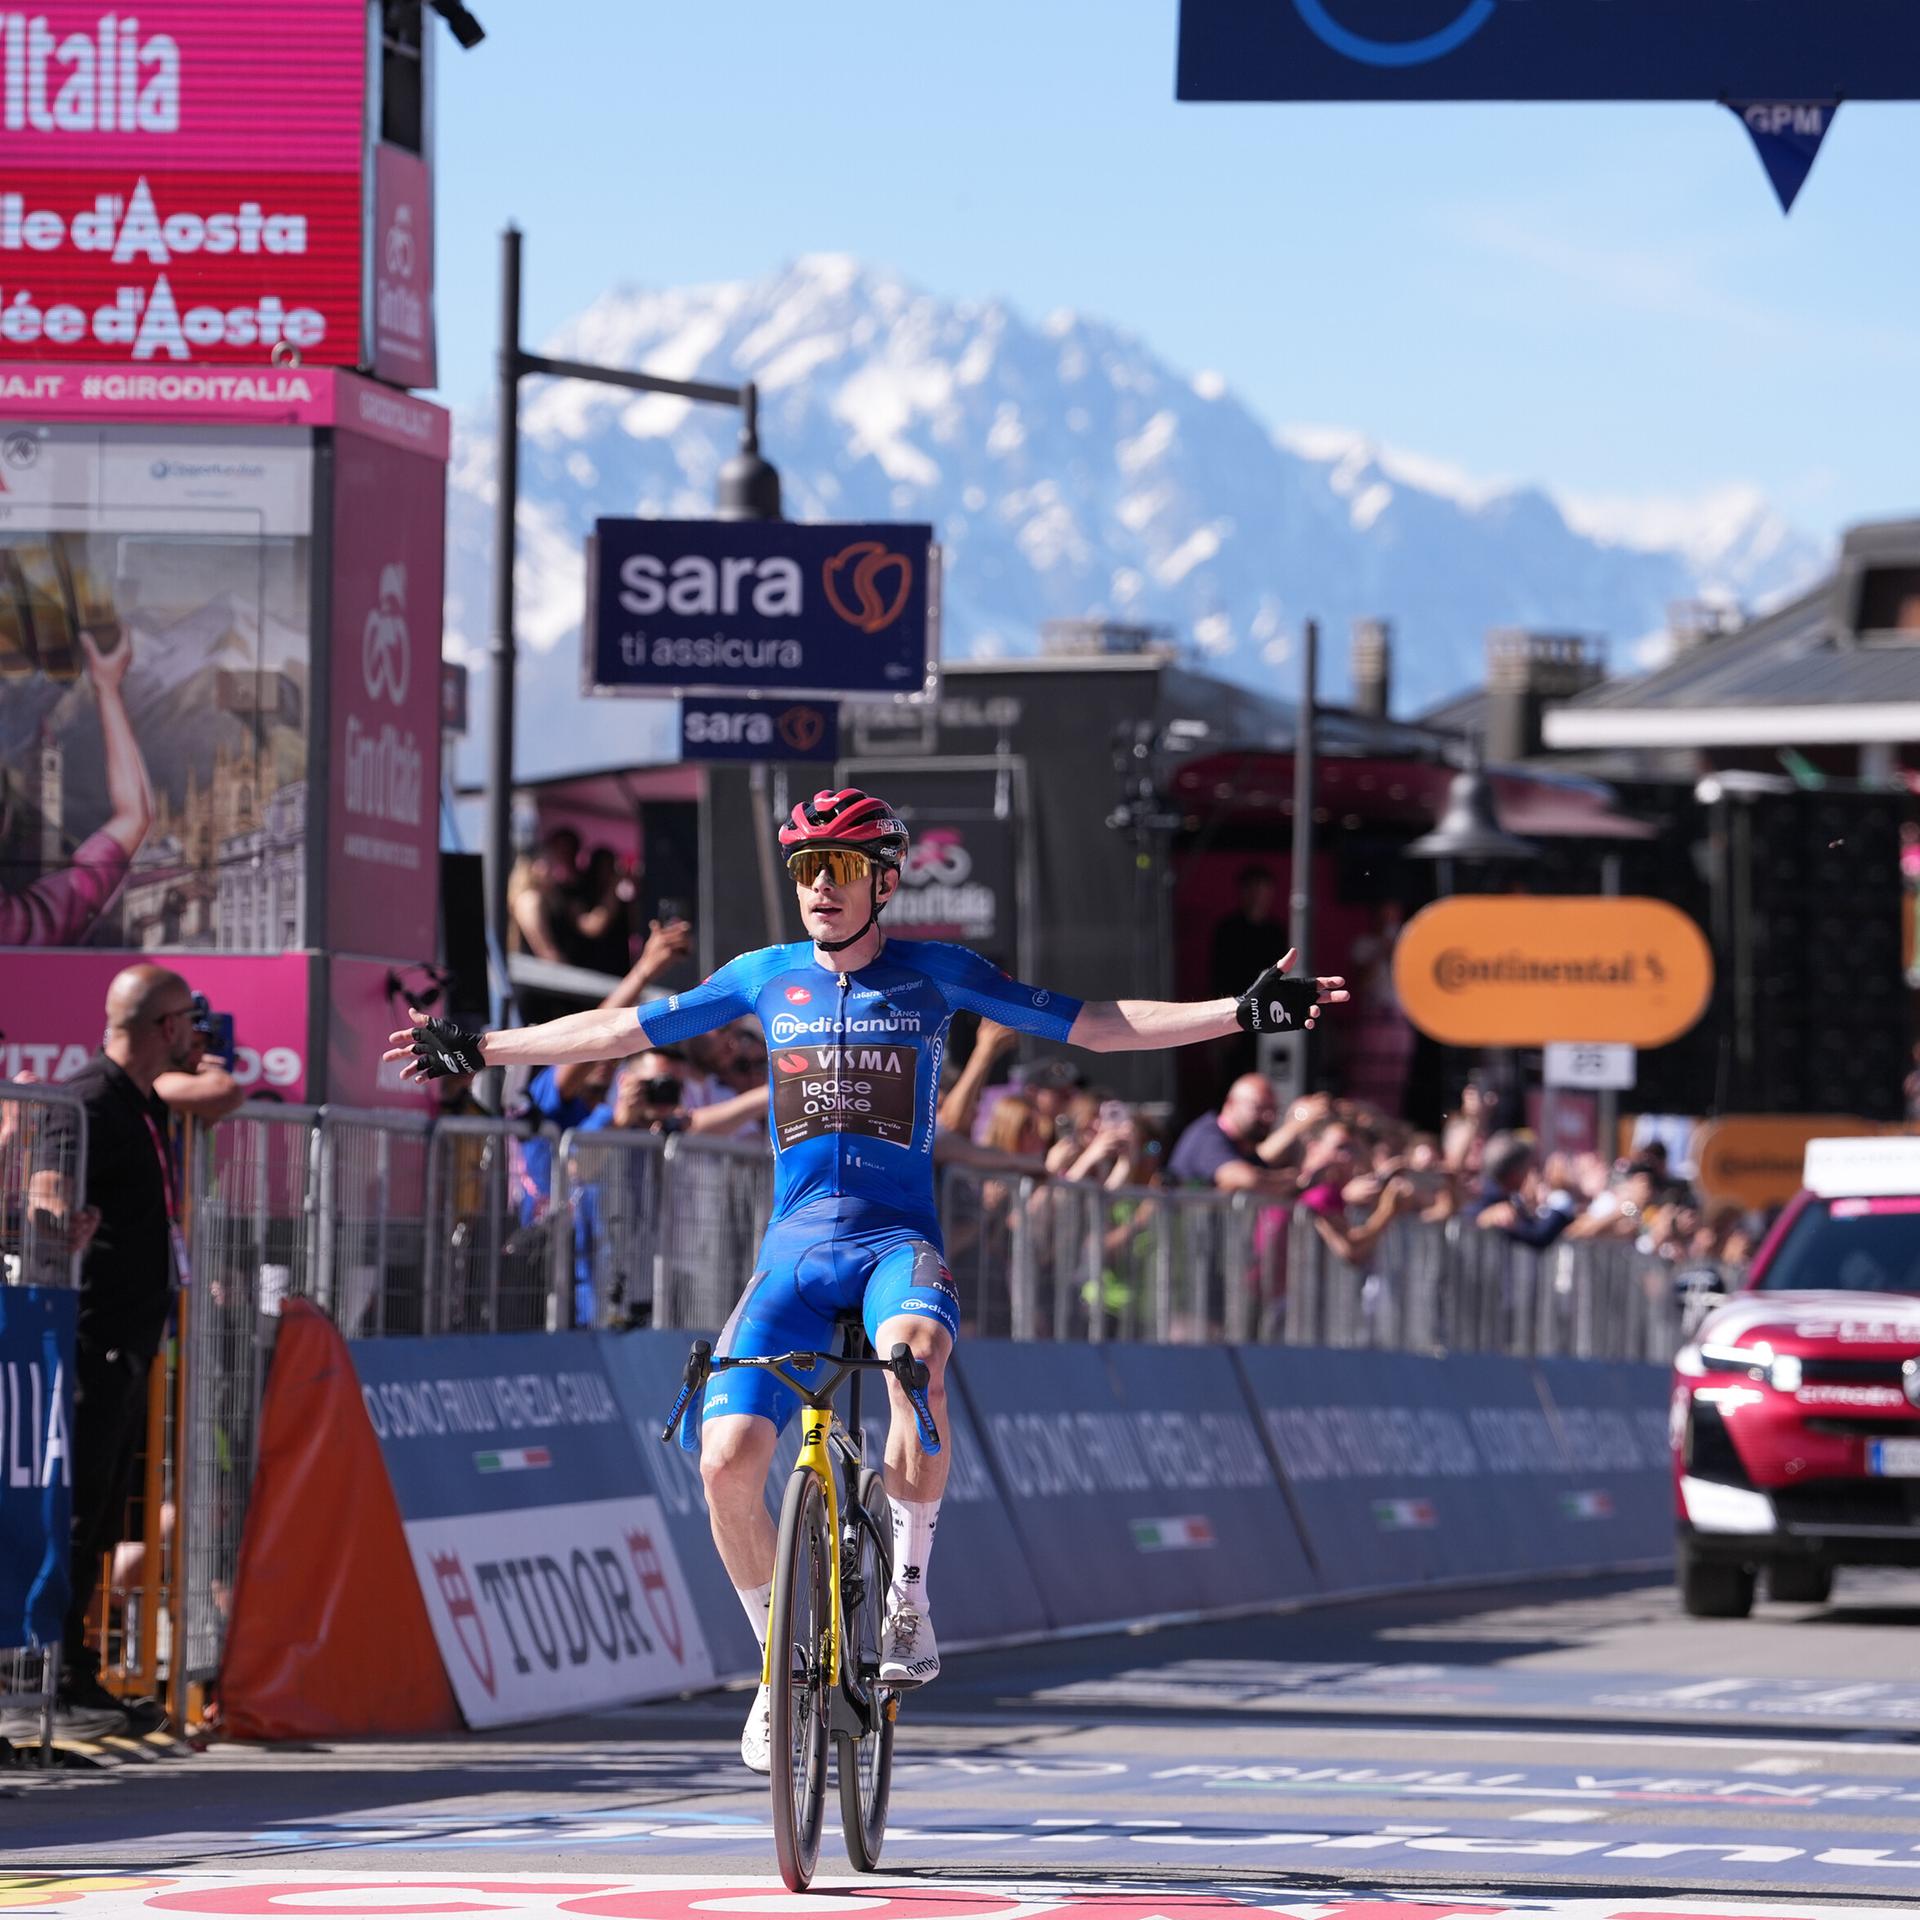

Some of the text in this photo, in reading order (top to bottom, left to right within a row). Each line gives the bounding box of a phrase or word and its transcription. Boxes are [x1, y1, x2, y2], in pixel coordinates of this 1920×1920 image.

[0, 11, 181, 133] Italia
[1744, 103, 1823, 136] GPM
[70, 176, 307, 264] d'Aosta
[0, 289, 86, 342] ée
[92, 273, 326, 359] d'Aoste
[81, 375, 312, 402] #GIRODITALIA
[618, 554, 803, 617] sara
[621, 633, 803, 668] ti assicura
[685, 710, 773, 744] sara
[773, 1014, 920, 1037] mediolanum
[890, 1010, 921, 1018] BANCA
[0, 1043, 88, 1080] ITA
[816, 1049, 902, 1074] VISMA
[801, 1080, 873, 1098] lease
[0, 1361, 71, 1488] LIA
[667, 1384, 690, 1428] SRAM
[911, 1389, 935, 1431] SRAM
[473, 1546, 655, 1674] TUDOR
[906, 1655, 940, 1678] nimbl
[144, 1881, 1818, 1920] CON
